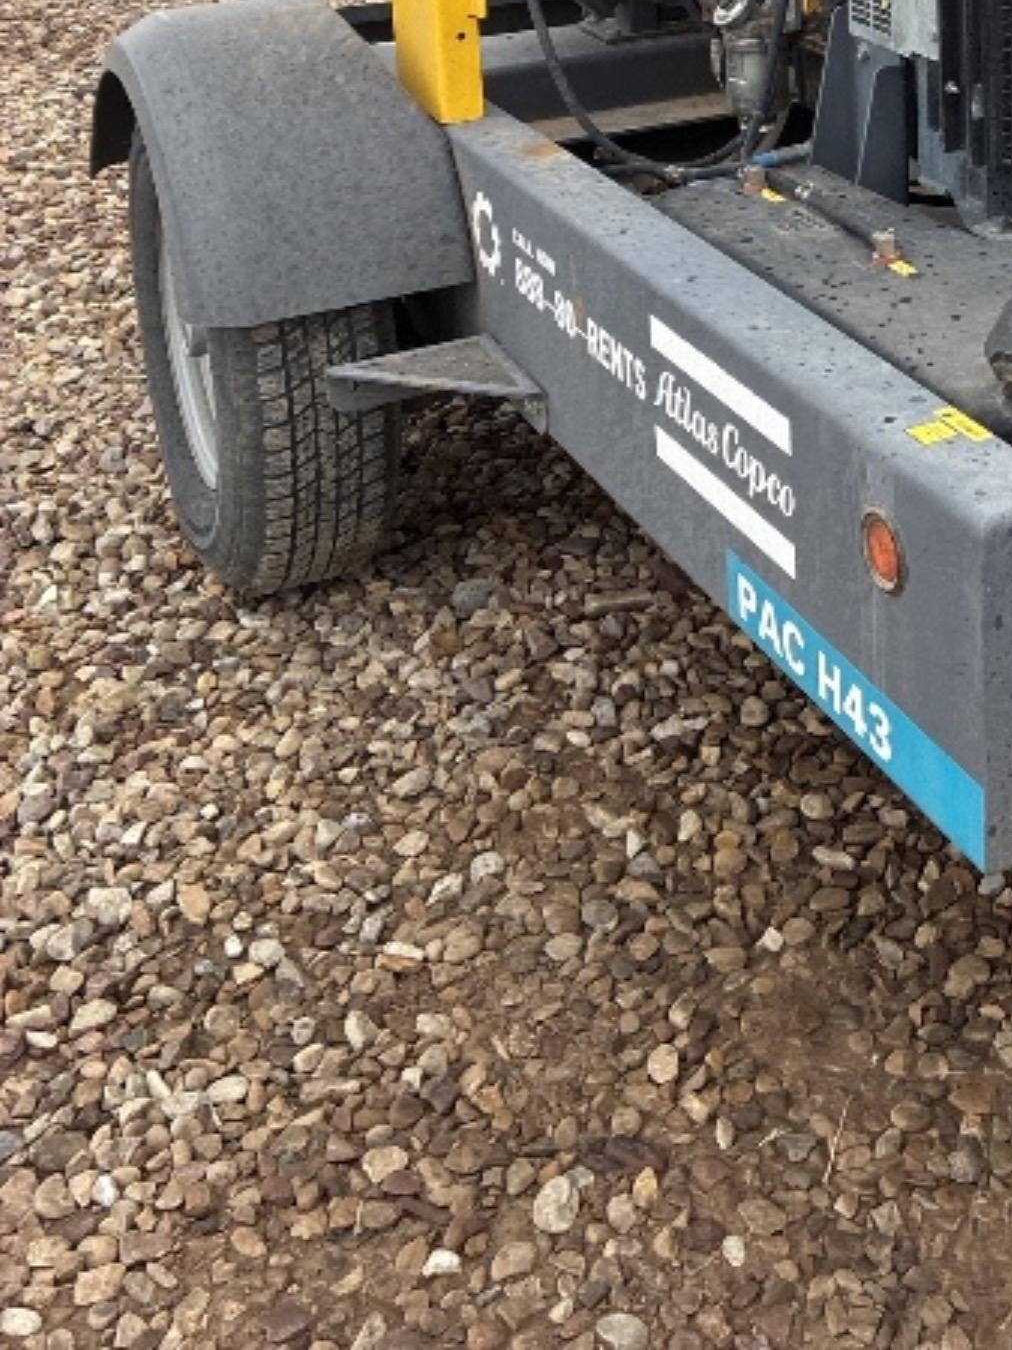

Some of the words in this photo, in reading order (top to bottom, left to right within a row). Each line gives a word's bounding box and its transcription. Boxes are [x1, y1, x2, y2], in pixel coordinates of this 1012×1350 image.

[653, 370, 720, 454] Atlas
[721, 421, 797, 518] Copco
[735, 570, 806, 678] PAC
[817, 648, 893, 764] H43
